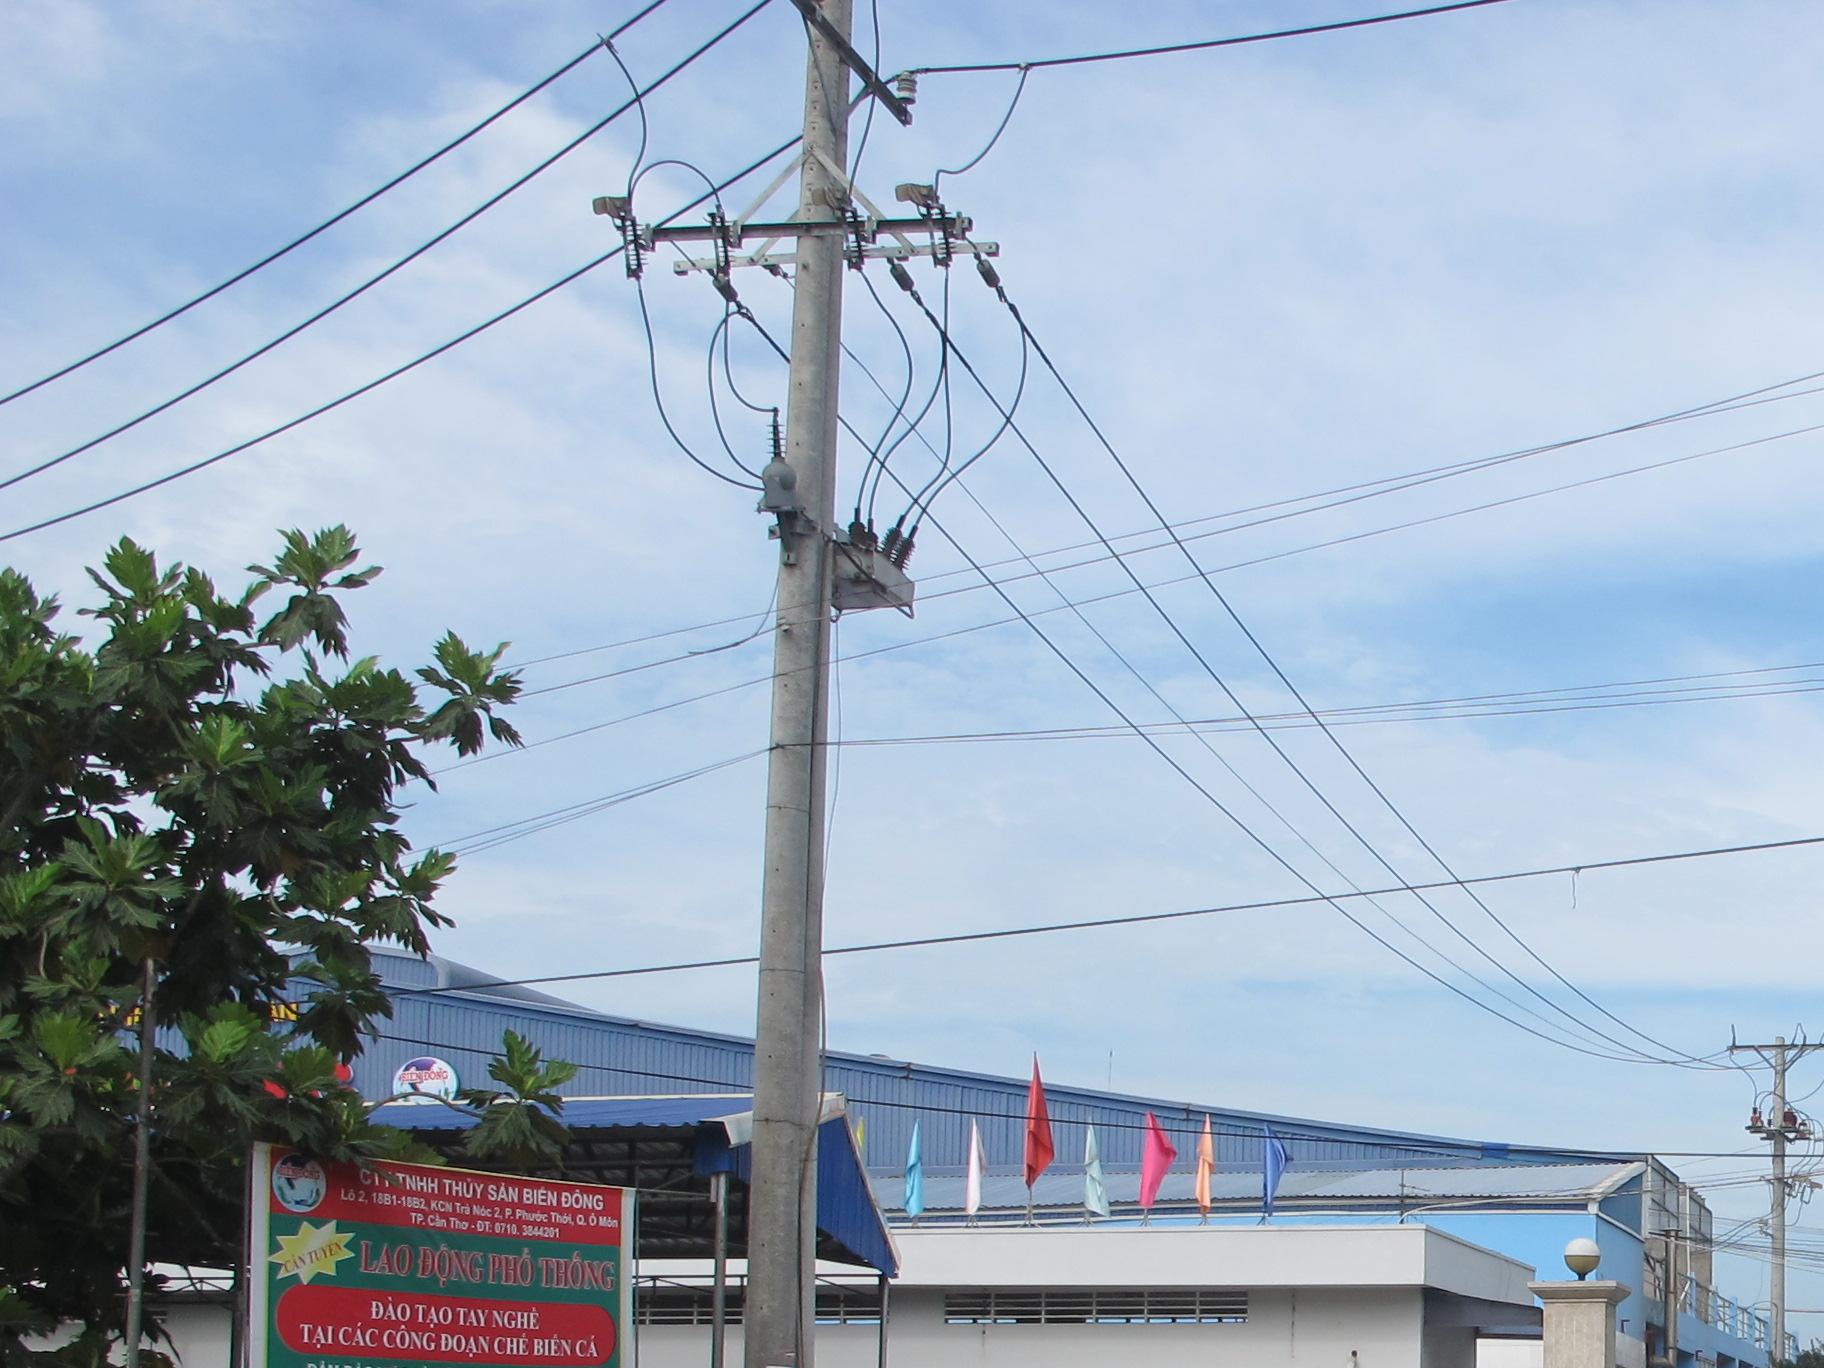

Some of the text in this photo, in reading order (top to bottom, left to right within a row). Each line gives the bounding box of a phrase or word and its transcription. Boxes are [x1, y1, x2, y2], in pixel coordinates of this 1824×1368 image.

[395, 1172, 438, 1194] TNHH
[443, 1177, 484, 1199] THỦY
[487, 1182, 519, 1203] SẢN
[561, 1189, 604, 1211] ĐÔNG
[430, 1199, 453, 1213] KCN
[410, 1212, 426, 1225] TP.
[360, 1240, 414, 1278] LAO
[416, 1243, 484, 1288] ĐỘNG
[370, 1296, 411, 1322] ĐÀO
[415, 1303, 453, 1328] TẠO
[456, 1307, 489, 1328] TAY
[300, 1323, 333, 1349] TẠI
[338, 1322, 379, 1347] CÁC
[383, 1325, 436, 1351] CÔNG
[440, 1333, 490, 1358] ĐOẠN
[575, 1335, 598, 1358] CÁ
